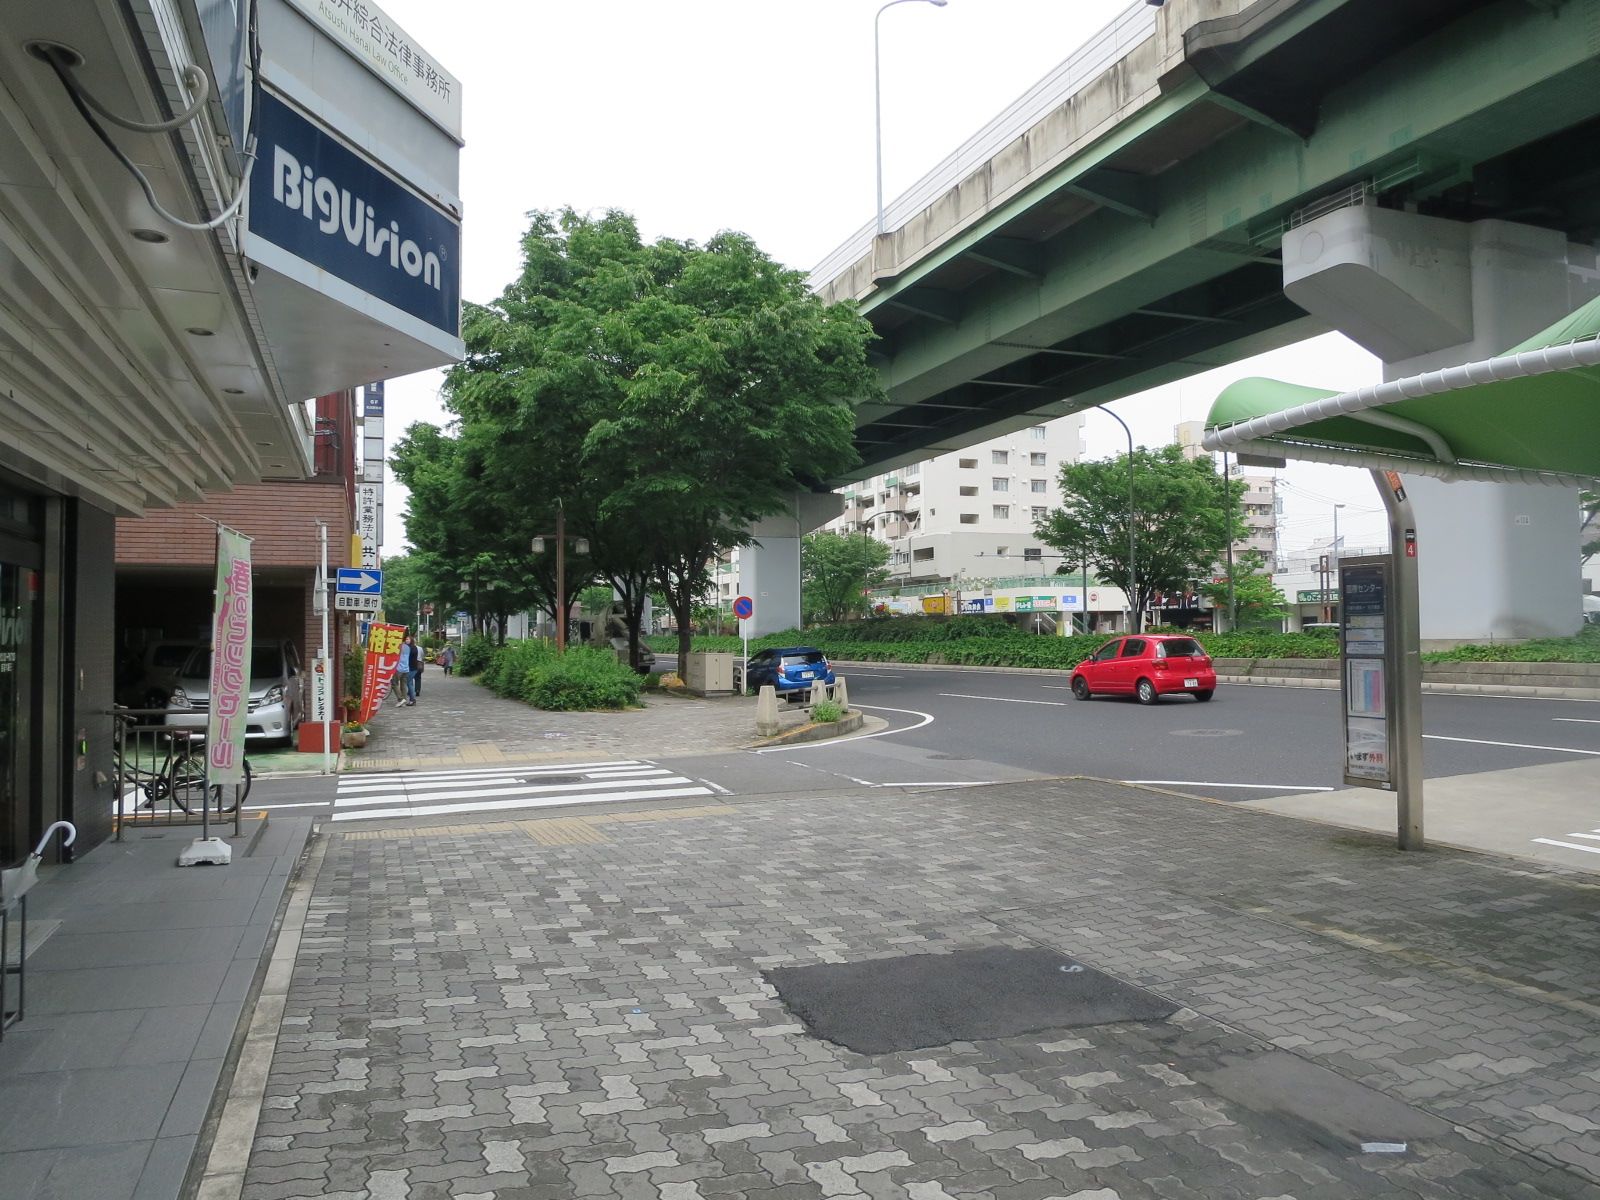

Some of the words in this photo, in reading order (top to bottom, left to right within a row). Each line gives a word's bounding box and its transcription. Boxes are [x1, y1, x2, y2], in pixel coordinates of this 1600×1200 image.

[318, 2, 348, 33] Atsushi
[349, 26, 371, 54] Hanai
[372, 46, 386, 66] Law
[388, 61, 408, 86] Office
[330, 0, 450, 104] 井綜合法律事務所
[362, 487, 375, 541] 特許業務法人
[1407, 545, 1414, 556] 4
[338, 597, 379, 608] 自動車・原付
[370, 626, 404, 655] 格安
